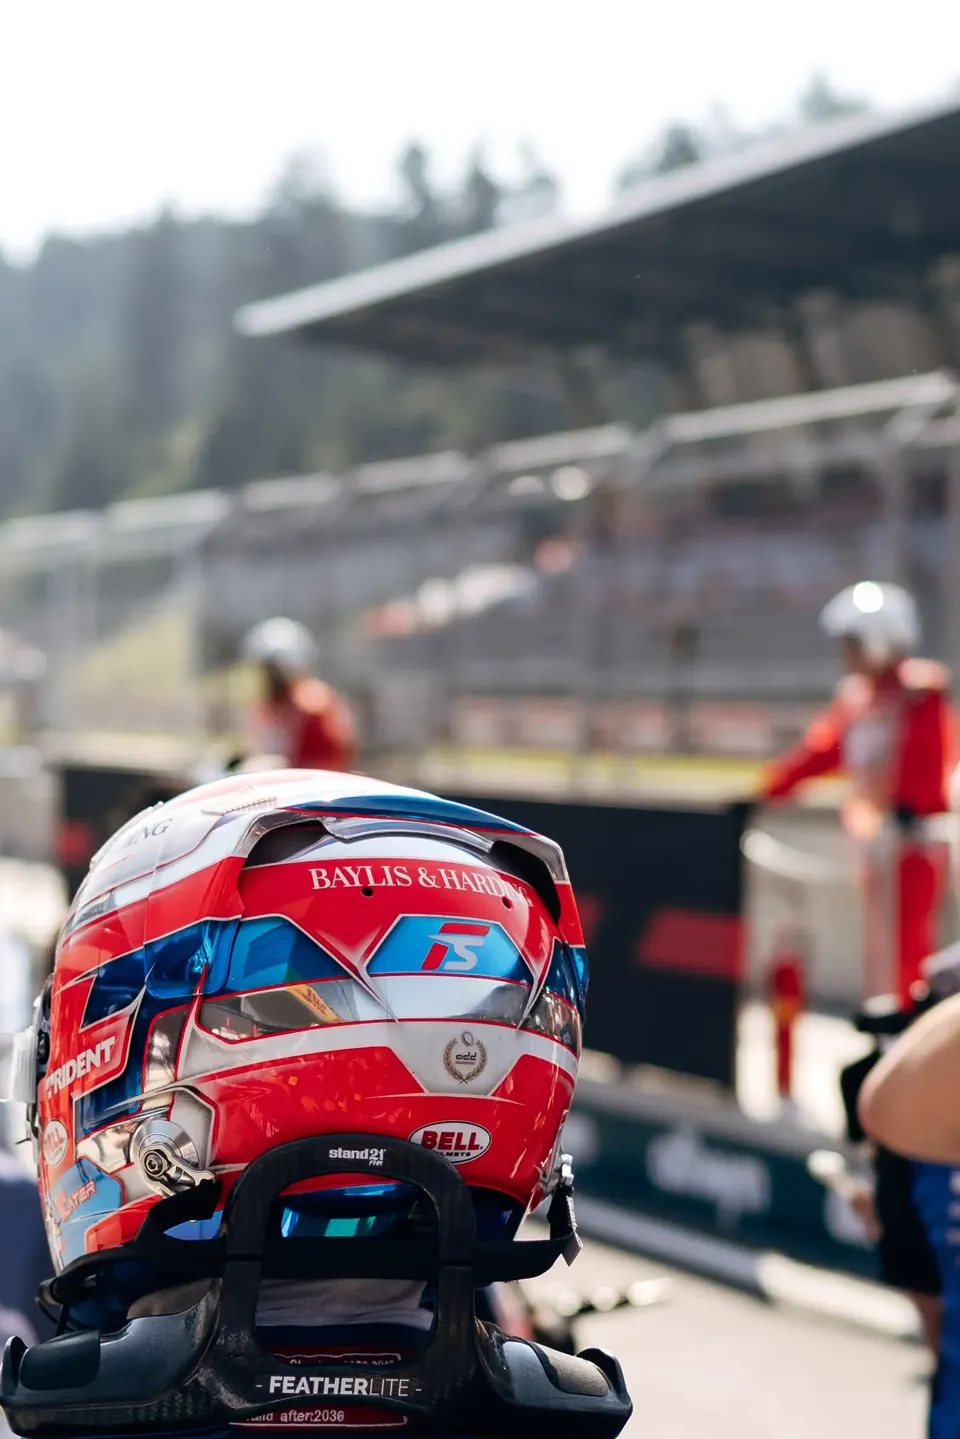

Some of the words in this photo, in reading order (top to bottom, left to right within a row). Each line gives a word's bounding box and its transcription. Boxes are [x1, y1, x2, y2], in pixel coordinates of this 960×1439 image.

[308, 865, 413, 890] BAYLIS
[418, 867, 441, 889] &
[438, 868, 533, 907] HARDING
[45, 1036, 116, 1099] TRIDENT
[421, 1130, 481, 1151] BELL
[328, 1147, 384, 1161] stand21
[269, 1375, 410, 1397] FEATHERLITE
